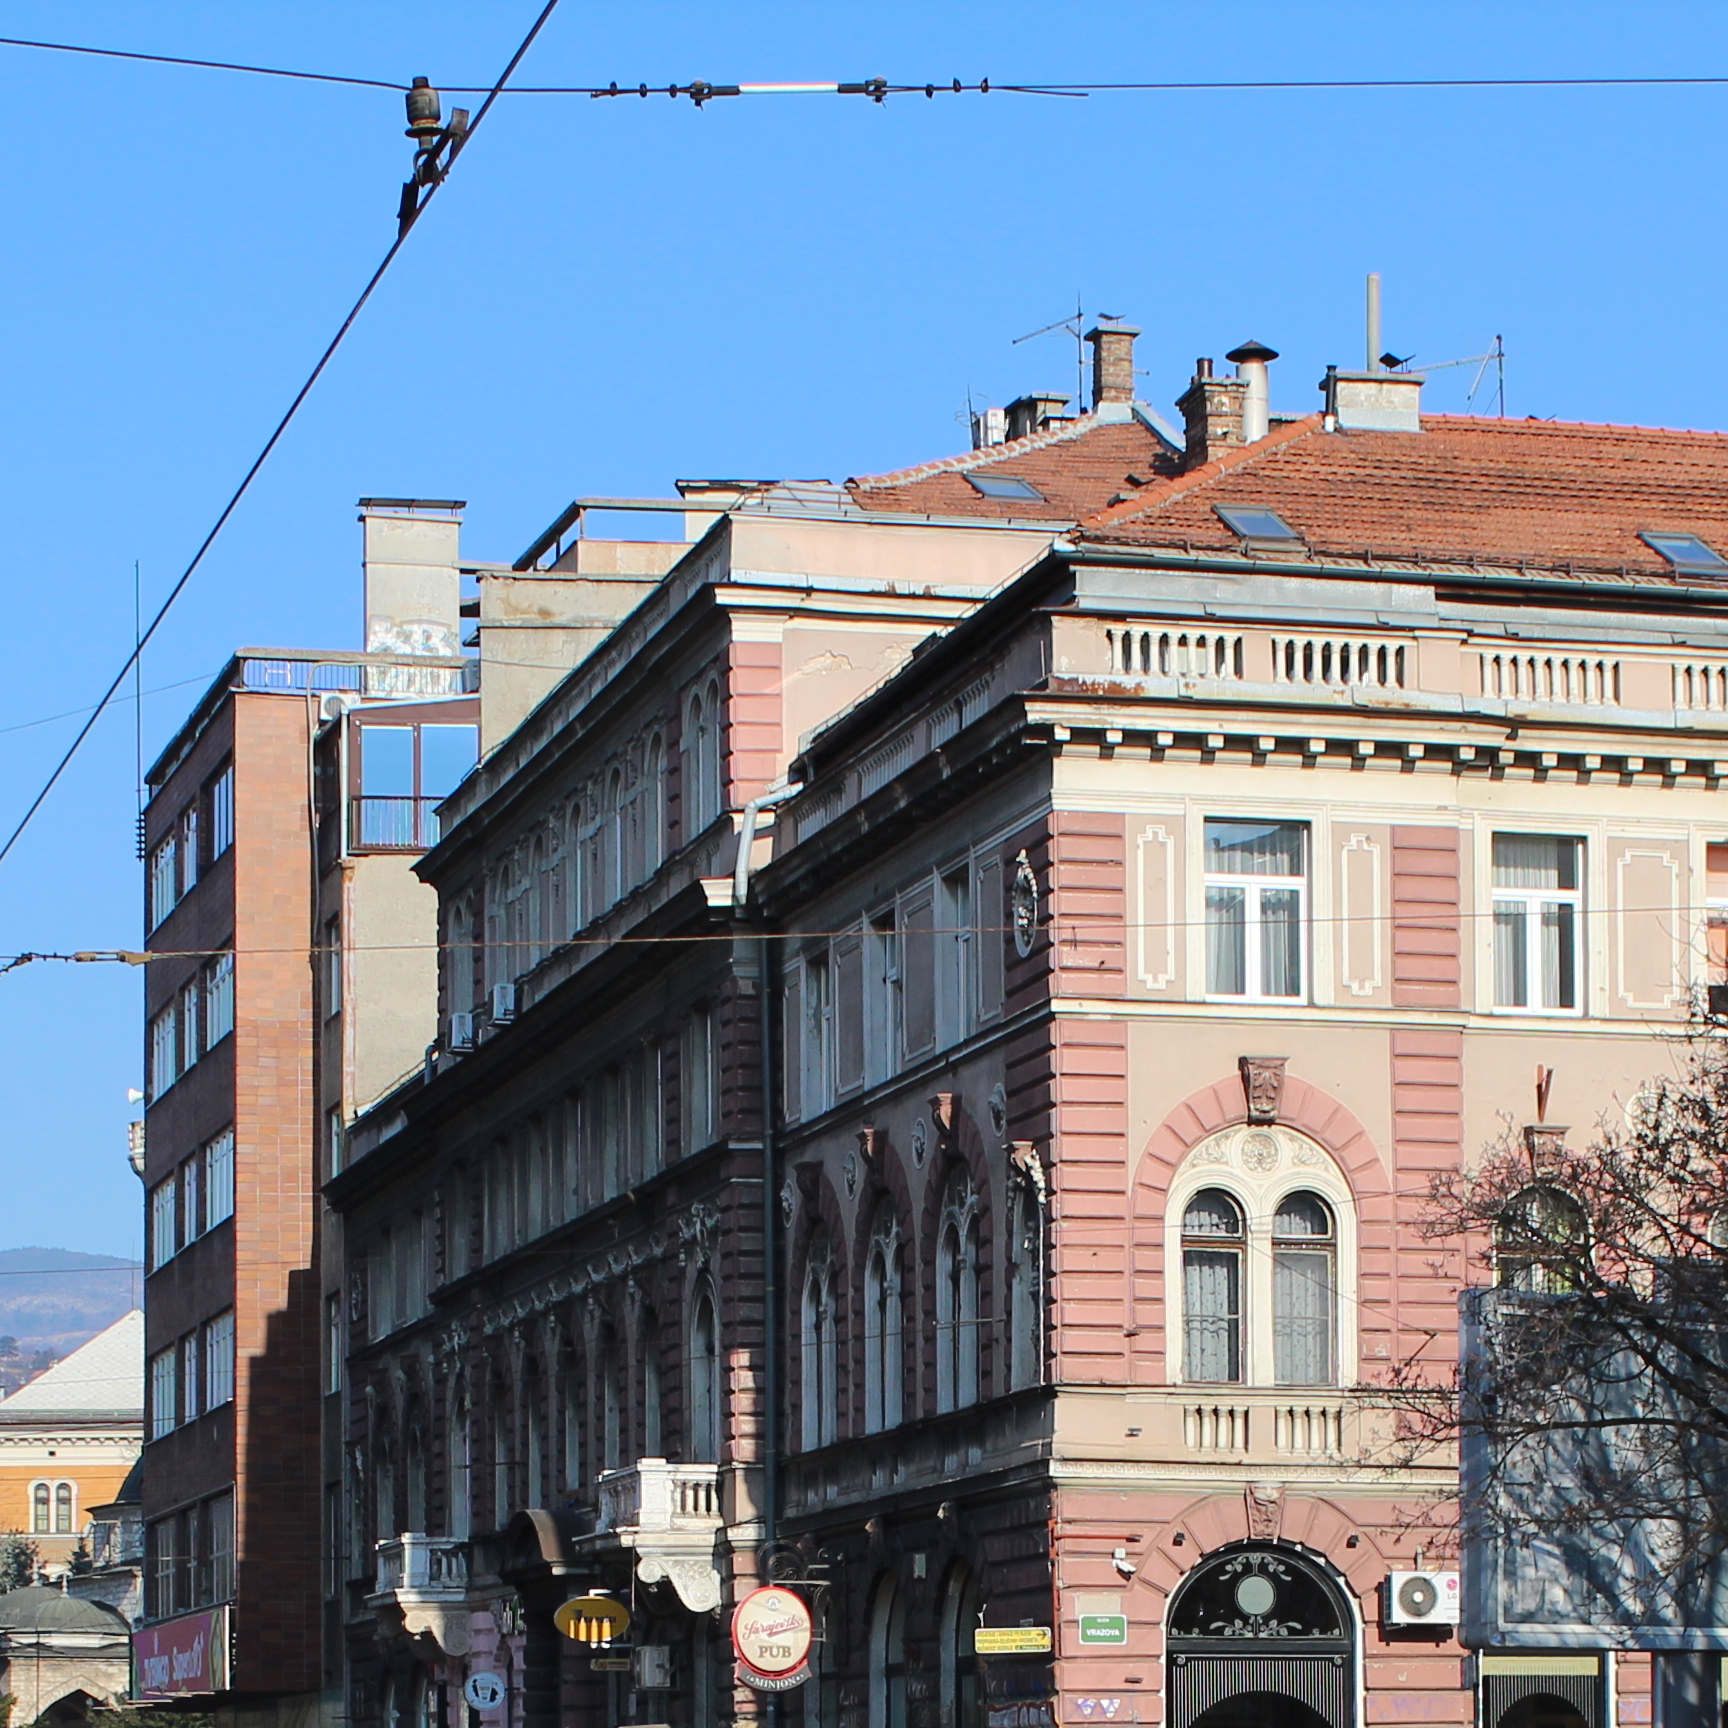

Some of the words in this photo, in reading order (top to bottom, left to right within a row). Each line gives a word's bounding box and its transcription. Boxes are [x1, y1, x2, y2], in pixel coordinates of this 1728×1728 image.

[1447, 1592, 1458, 1600] LG
[757, 1645, 792, 1658] PUB
[754, 1677, 797, 1690] MINJON
